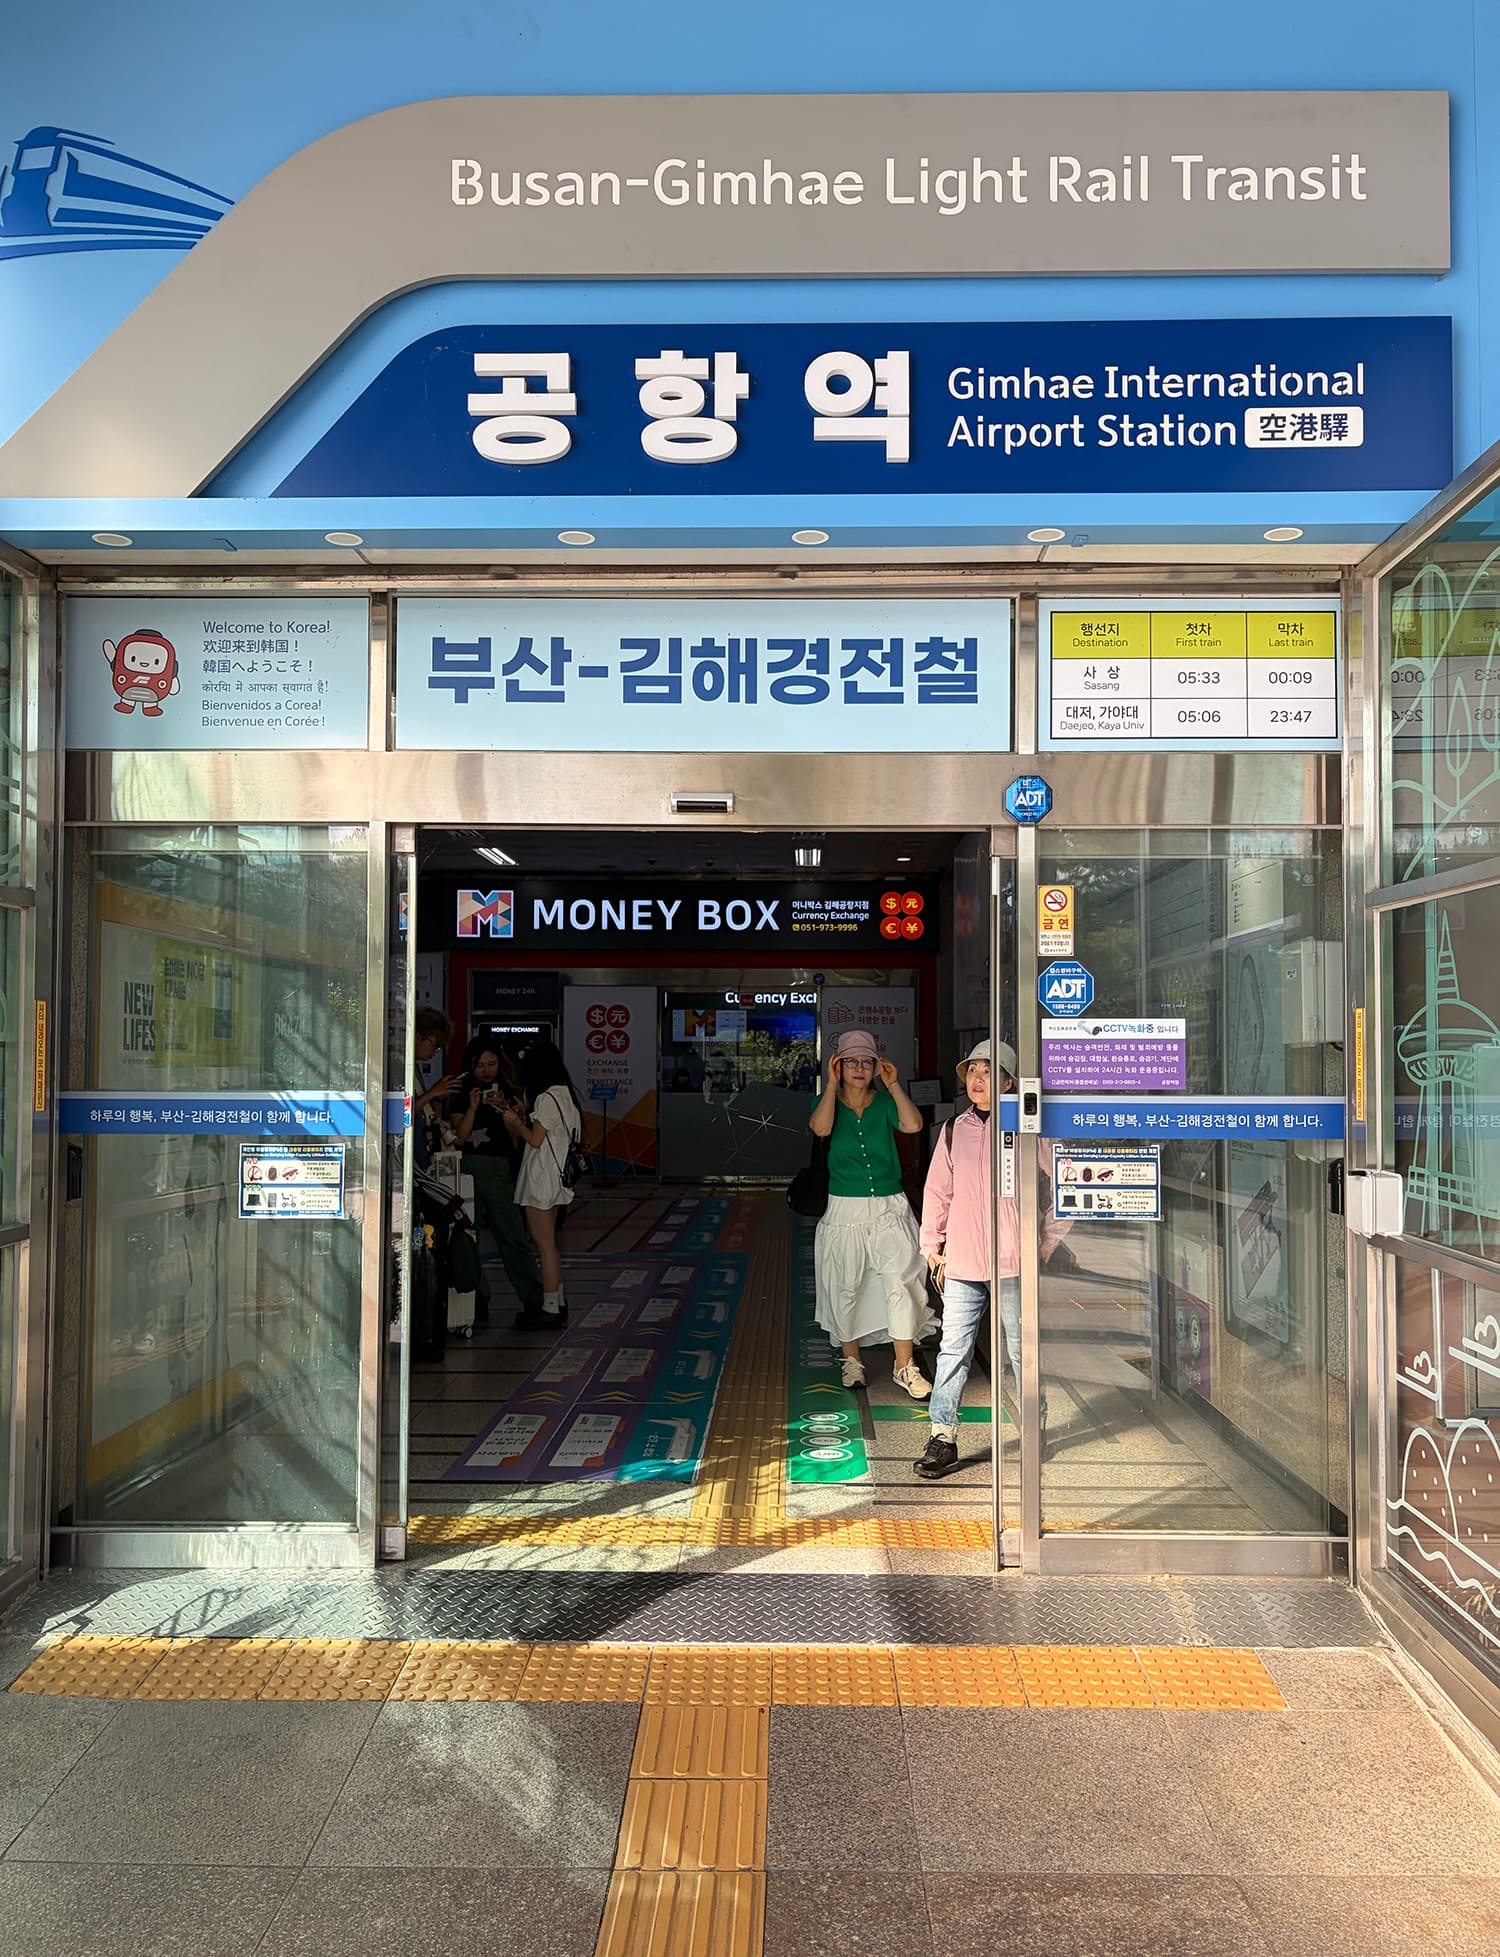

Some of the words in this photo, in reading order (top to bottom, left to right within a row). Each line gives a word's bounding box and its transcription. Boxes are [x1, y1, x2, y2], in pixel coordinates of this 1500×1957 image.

[451, 158, 864, 206] Busan-Gimhae
[886, 157, 1028, 216] Light
[1049, 155, 1149, 203] Rail
[1170, 154, 1367, 201] Transit
[948, 366, 1095, 400] Gimhae
[1104, 362, 1364, 398] International
[947, 414, 1085, 455] Airport
[1097, 413, 1236, 447] Station
[1258, 413, 1349, 441] 空港驛
[202, 621, 264, 634] Welcome
[268, 621, 282, 634] to
[287, 620, 330, 634] Korea!
[1080, 622, 1120, 637] 행선지
[1185, 622, 1212, 637] 첫차
[1277, 622, 1305, 637] 막차
[1072, 638, 1129, 648] Destination
[1175, 638, 1197, 648] First
[1199, 638, 1222, 648] train
[1268, 638, 1290, 648] Last
[1291, 638, 1314, 648] train
[427, 637, 978, 705] 부산-김해경전철
[1177, 671, 1221, 685] 05:33
[1268, 671, 1313, 685] 00:09
[1083, 681, 1120, 692] Sasang
[201, 699, 272, 711] Bienvenidos
[274, 703, 282, 711] a
[284, 699, 322, 711] Corea!
[1066, 705, 1096, 720] 대저,
[1099, 705, 1139, 719] 가야대
[1177, 710, 1221, 723] 05:06
[1270, 710, 1312, 723] 23:47
[201, 716, 265, 727] Bienvenue
[267, 718, 282, 727] en
[1060, 721, 1096, 731] Daejeo,
[1098, 720, 1121, 731] Kaya
[1123, 720, 1145, 730] Univ
[1014, 790, 1045, 807] ADT
[792, 901, 823, 910] 머니박스
[824, 901, 869, 910] 김해공항지점
[533, 899, 682, 931] MONEY
[698, 899, 780, 931] BOX
[792, 912, 829, 921] Currency
[830, 912, 870, 921] Exchange
[800, 923, 858, 931] 051-973-9996
[1046, 978, 1085, 999] ADT
[725, 992, 788, 1007] Cuency
[1103, 1024, 1154, 1033] CCTV녹화중
[1157, 1025, 1179, 1033] 입니다
[586, 1059, 629, 1067] EXCHANGE
[90, 1109, 126, 1123] 하루의
[129, 1109, 157, 1124] 행복,
[160, 1109, 263, 1124] 부산-김해경전철이
[266, 1109, 290, 1124] 함께
[294, 1109, 335, 1124] 합니다.
[1072, 1113, 1109, 1127] 하루의
[1113, 1113, 1141, 1128] 행복,
[1145, 1113, 1250, 1128] 부산-김해경전철이
[1254, 1113, 1279, 1128] 함께
[1283, 1113, 1323, 1128] 합니다.
